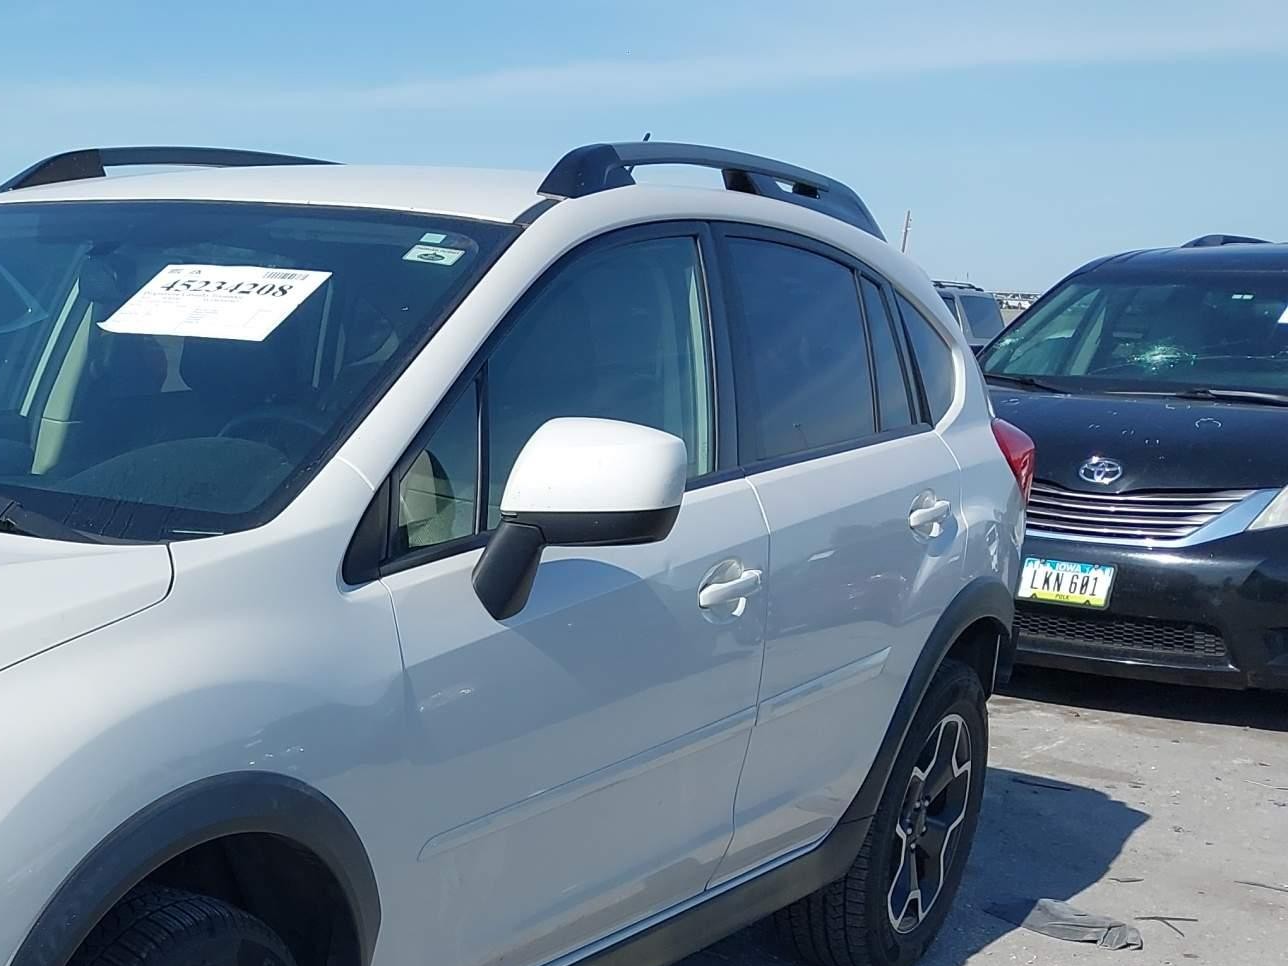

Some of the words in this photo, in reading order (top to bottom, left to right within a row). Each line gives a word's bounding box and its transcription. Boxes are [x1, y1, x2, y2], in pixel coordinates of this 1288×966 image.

[161, 279, 295, 298] 45234208
[1056, 561, 1082, 573] IOWA
[1030, 569, 1065, 593] LKN
[1068, 574, 1099, 597] 601
